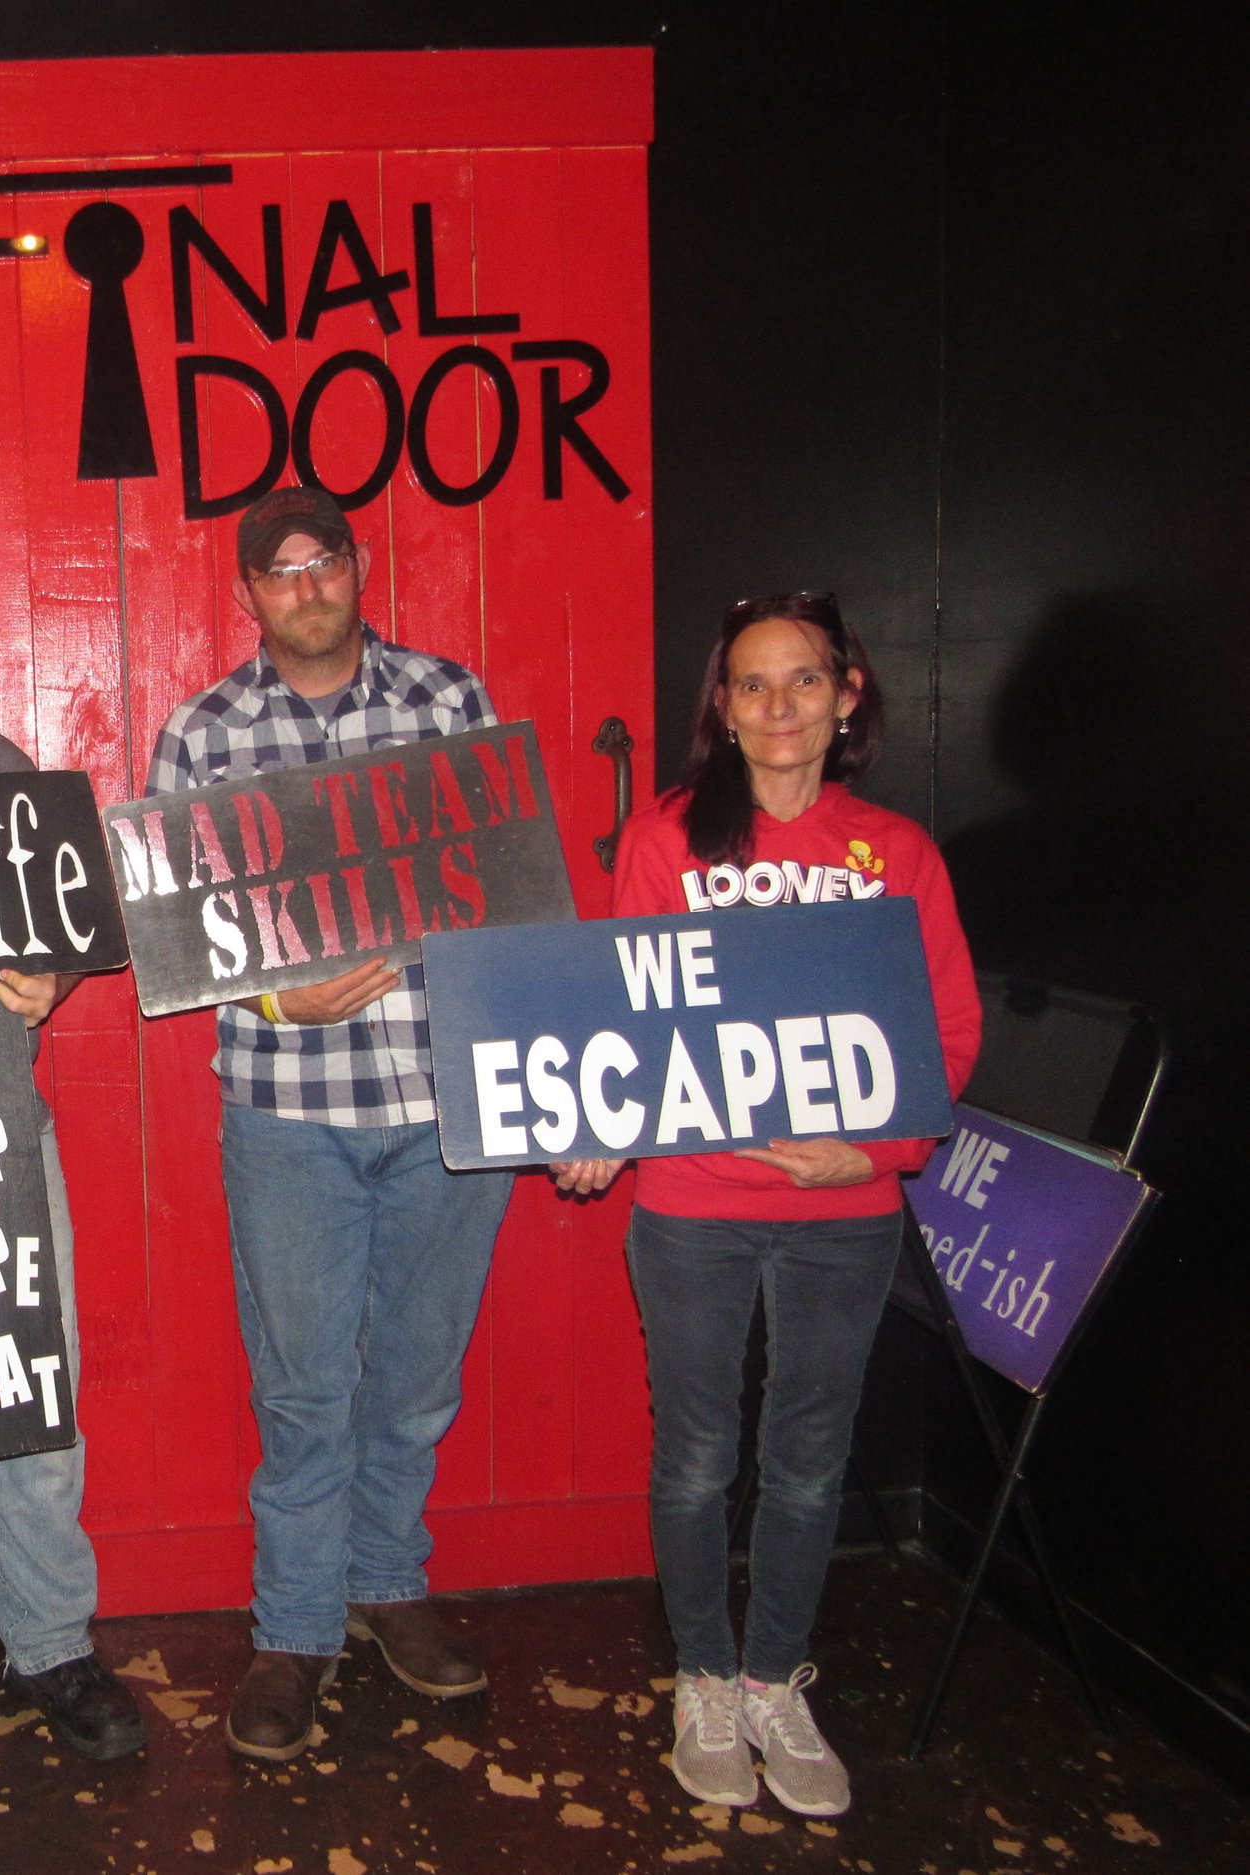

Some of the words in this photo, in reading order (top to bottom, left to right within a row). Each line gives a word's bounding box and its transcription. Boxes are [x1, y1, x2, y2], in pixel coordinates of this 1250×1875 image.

[175, 339, 632, 520] DOOR
[110, 791, 284, 901] MAD
[313, 736, 541, 858] TEAM
[680, 859, 886, 913] LOONEY
[202, 841, 487, 980] SKILLS
[615, 930, 722, 1011] WE
[472, 1013, 896, 1157] ESCAPED
[939, 1128, 1010, 1209] WE
